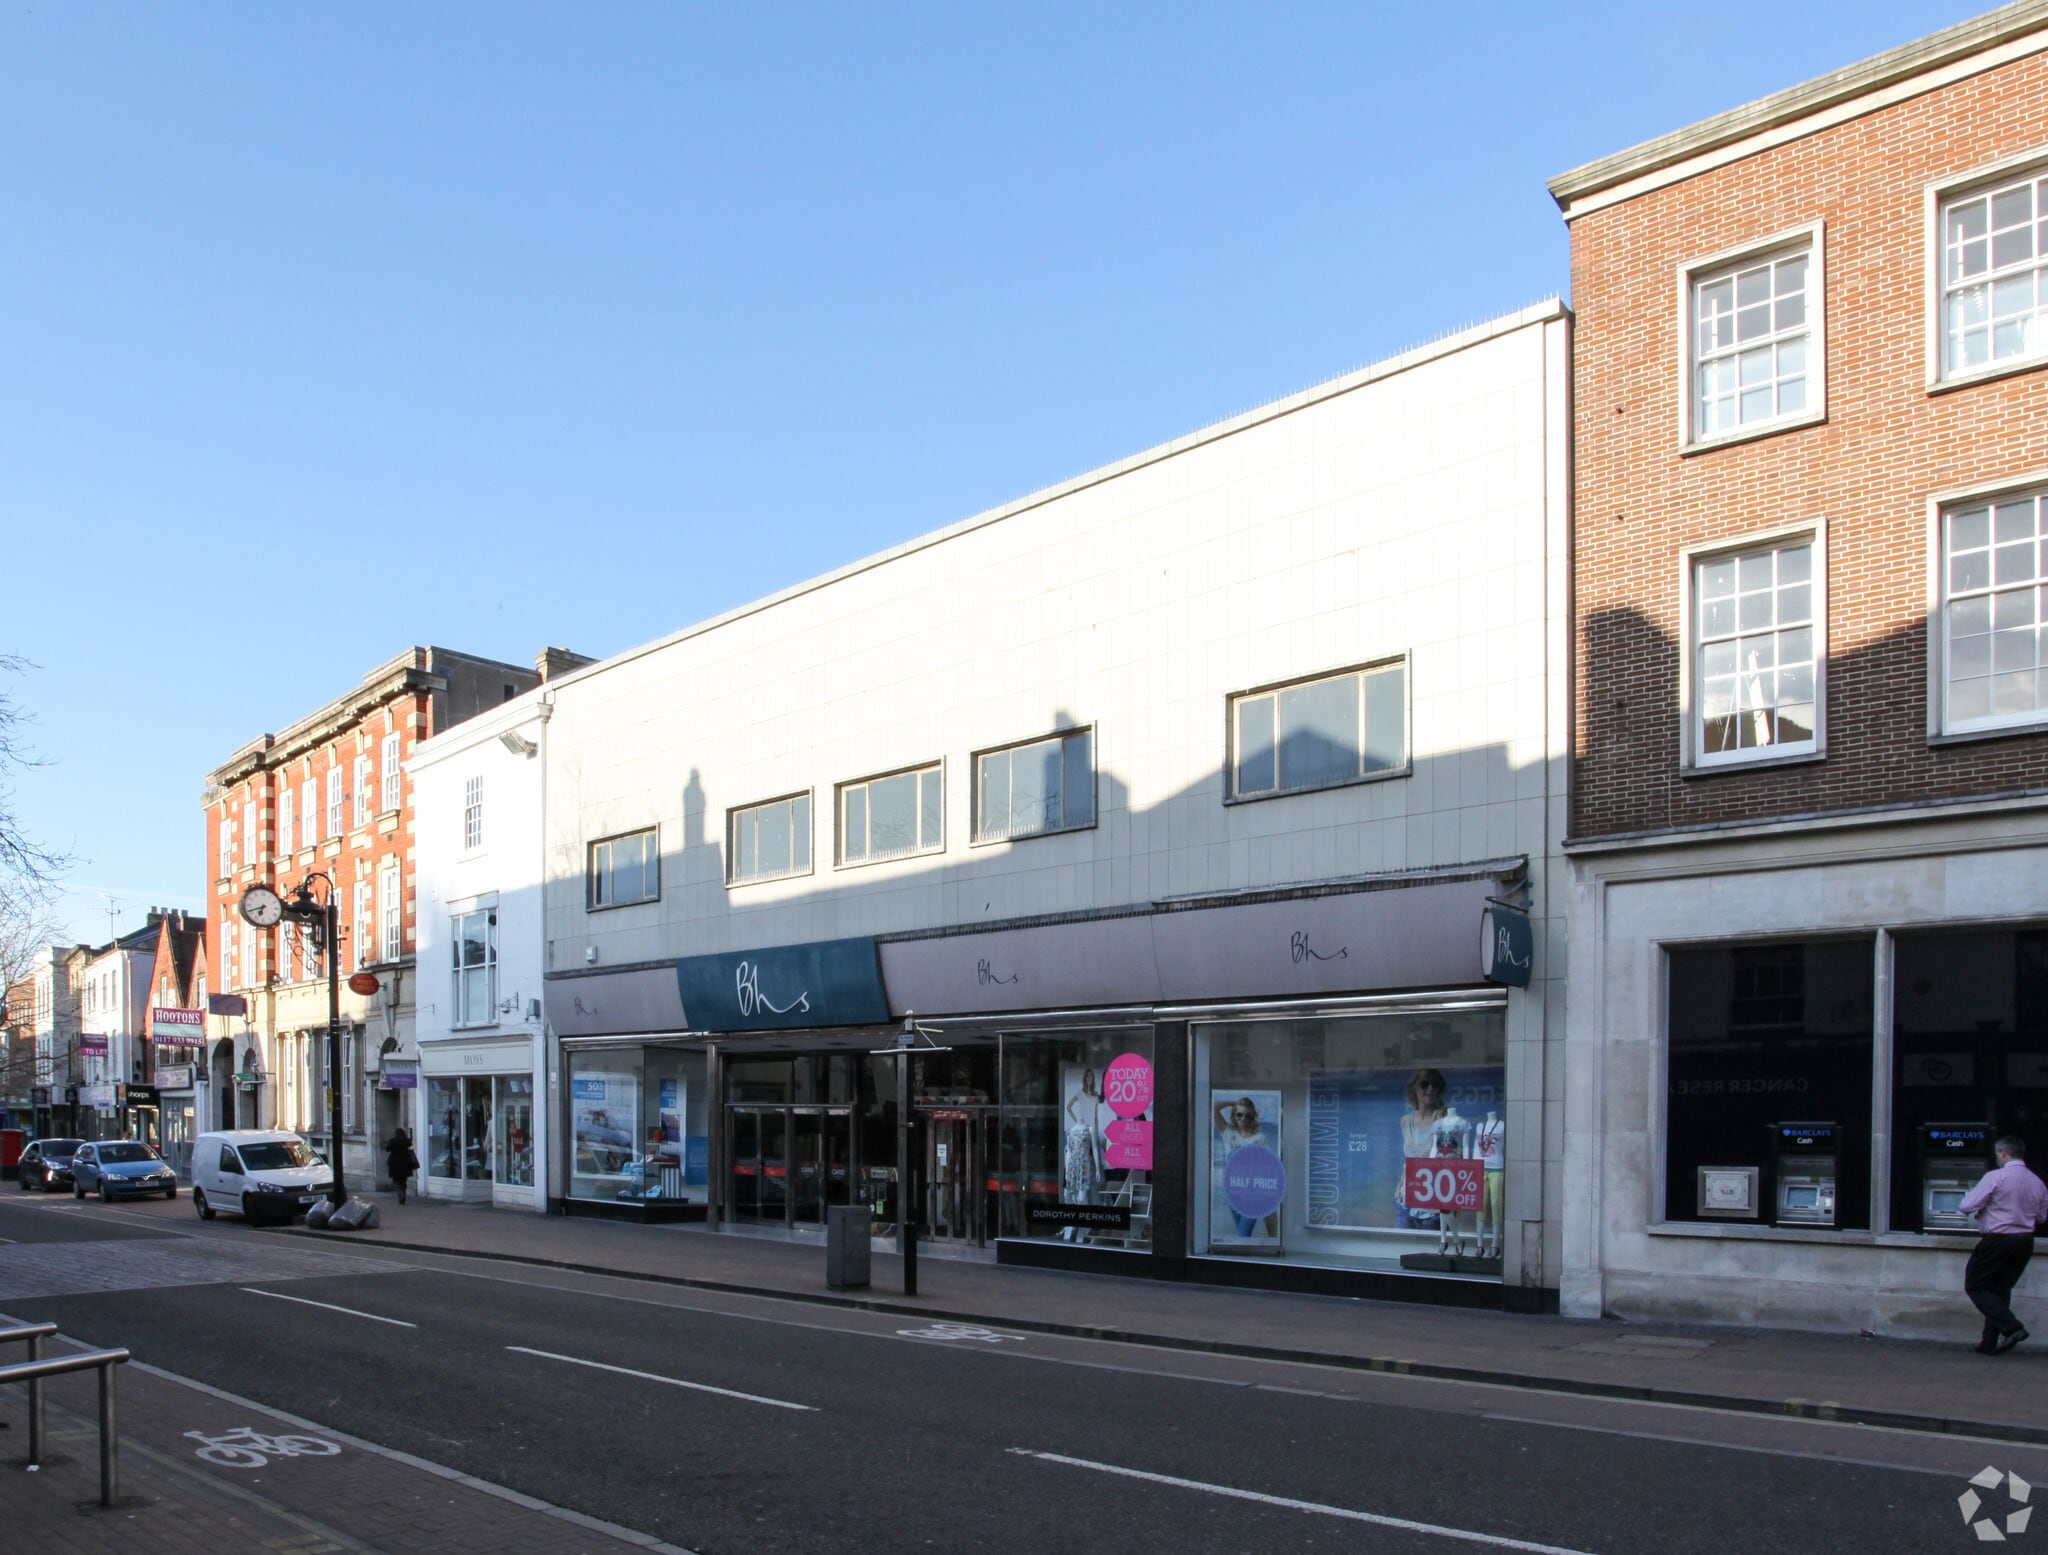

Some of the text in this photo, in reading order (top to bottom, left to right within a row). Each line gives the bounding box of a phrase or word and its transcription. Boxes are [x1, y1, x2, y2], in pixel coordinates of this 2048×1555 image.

[1291, 931, 1348, 963] Bhs
[1498, 927, 1530, 968] Bhs
[978, 958, 1018, 986] Bhs
[736, 960, 810, 1017] Bhs
[155, 1010, 201, 1024] HOOTONS
[464, 1055, 483, 1065] MOSS
[1110, 1068, 1148, 1080] TODAY
[1125, 1124, 1141, 1132] ALL
[1791, 1129, 1831, 1137] BARCLAYS
[1940, 1131, 1984, 1139] BARCLAYS
[1348, 1141, 1367, 1151] £28
[1797, 1137, 1813, 1145] Cash
[1946, 1139, 1964, 1148] Cash
[1124, 1148, 1141, 1157] ALL
[1230, 1176, 1279, 1190] HALF PRICE
[1455, 1194, 1477, 1205] OFF
[1033, 1209, 1121, 1222] DOROTHY PERKINS
